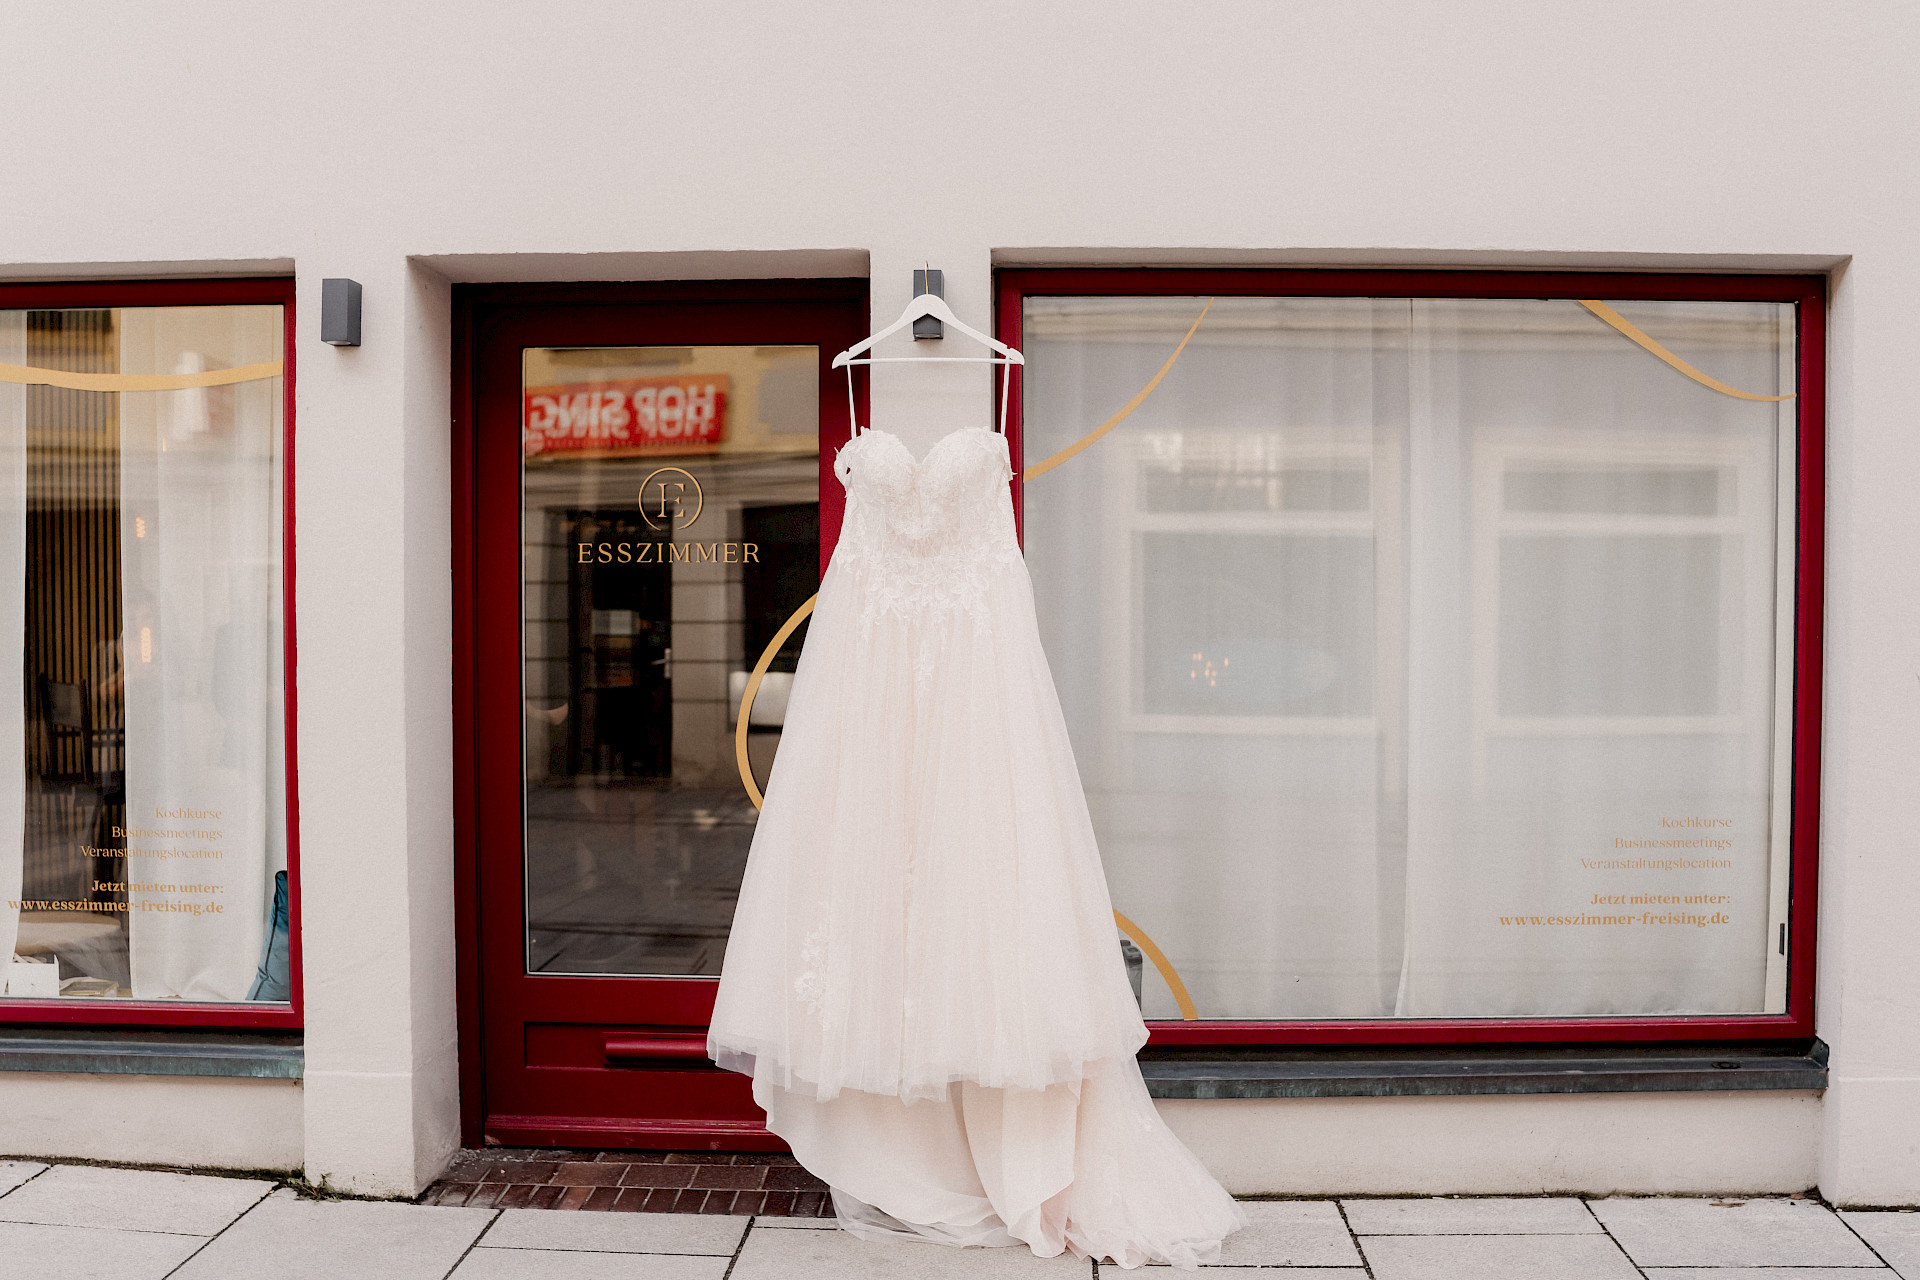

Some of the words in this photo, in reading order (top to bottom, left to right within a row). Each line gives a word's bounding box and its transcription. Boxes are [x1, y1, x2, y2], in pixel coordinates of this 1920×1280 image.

[656, 483, 685, 518] E
[577, 542, 760, 564] ESSZIMMER
[155, 807, 222, 820] Kochkurse
[1662, 816, 1733, 828] Kochkurse
[112, 826, 223, 841] Businessmeetings
[1615, 837, 1732, 850] Businessmeetings
[80, 845, 223, 860] Veranstaltungslocation
[1580, 857, 1731, 871] Veranstaltungslocation
[91, 880, 126, 893] Jetzt
[129, 880, 176, 893] mieten
[179, 882, 224, 894] unter:
[1590, 893, 1626, 905] Jetzt
[1630, 893, 1681, 905] mieten
[1684, 893, 1731, 904] unter:
[8, 898, 224, 916] www.esszimmer-freising.de
[1499, 912, 1730, 928] www.esszimmer-freising.de
